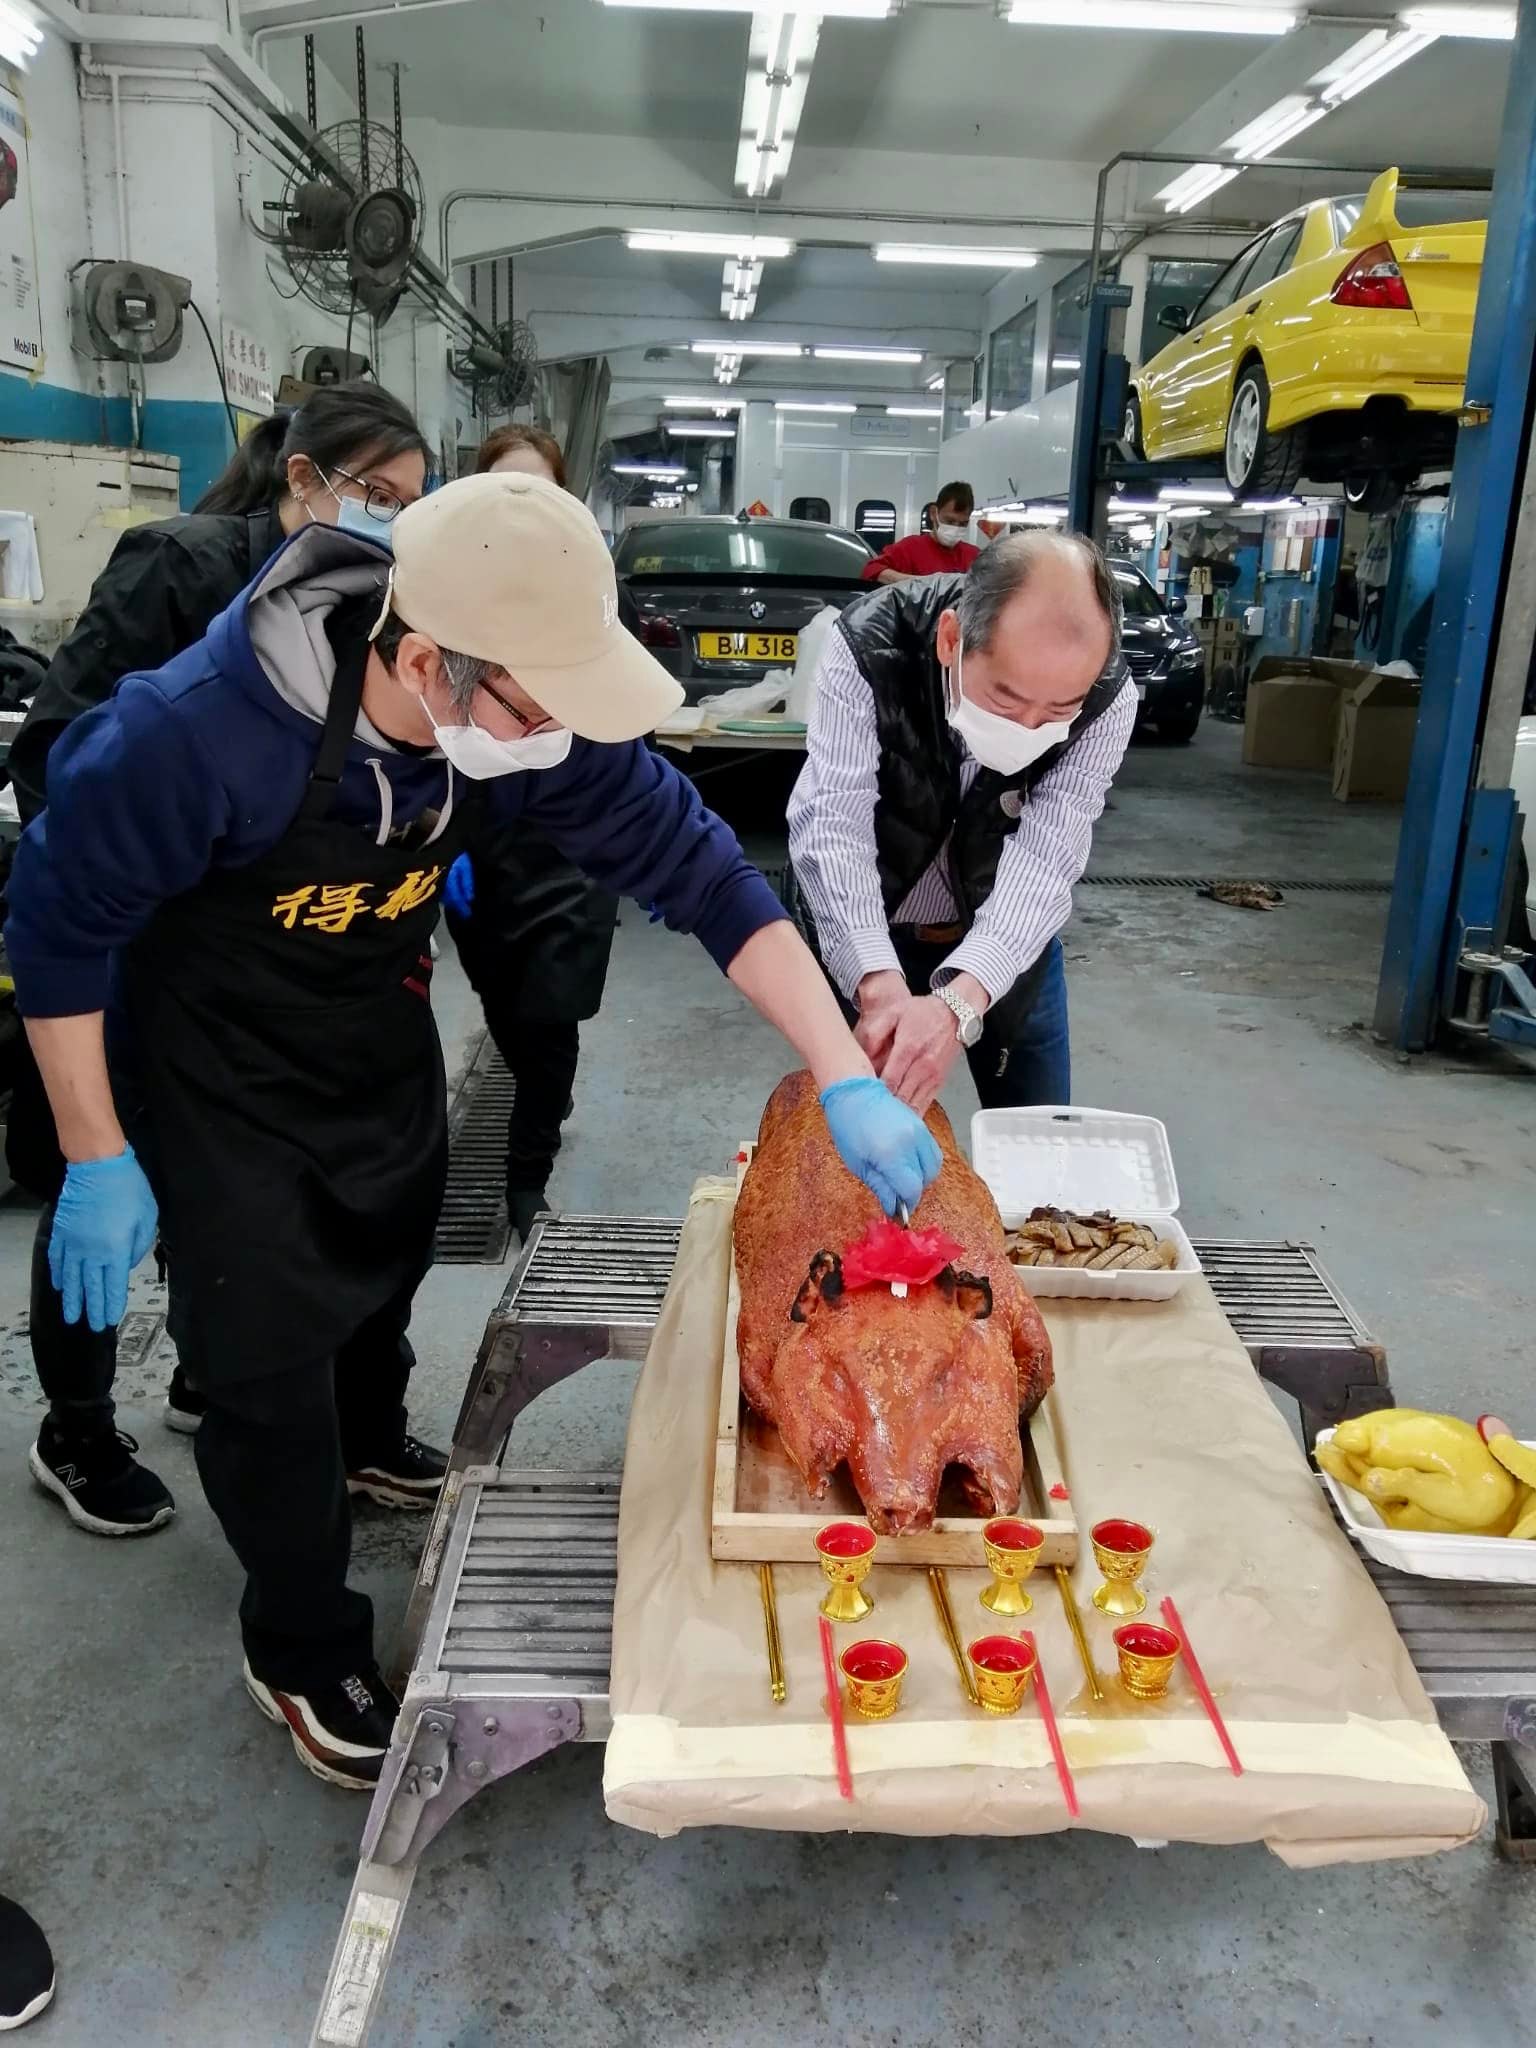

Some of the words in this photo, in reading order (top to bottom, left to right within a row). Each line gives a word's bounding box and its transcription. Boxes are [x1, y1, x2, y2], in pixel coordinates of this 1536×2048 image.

[13, 337, 31, 356] Mobil
[717, 636, 749, 656] BM
[756, 637, 795, 657] 318
